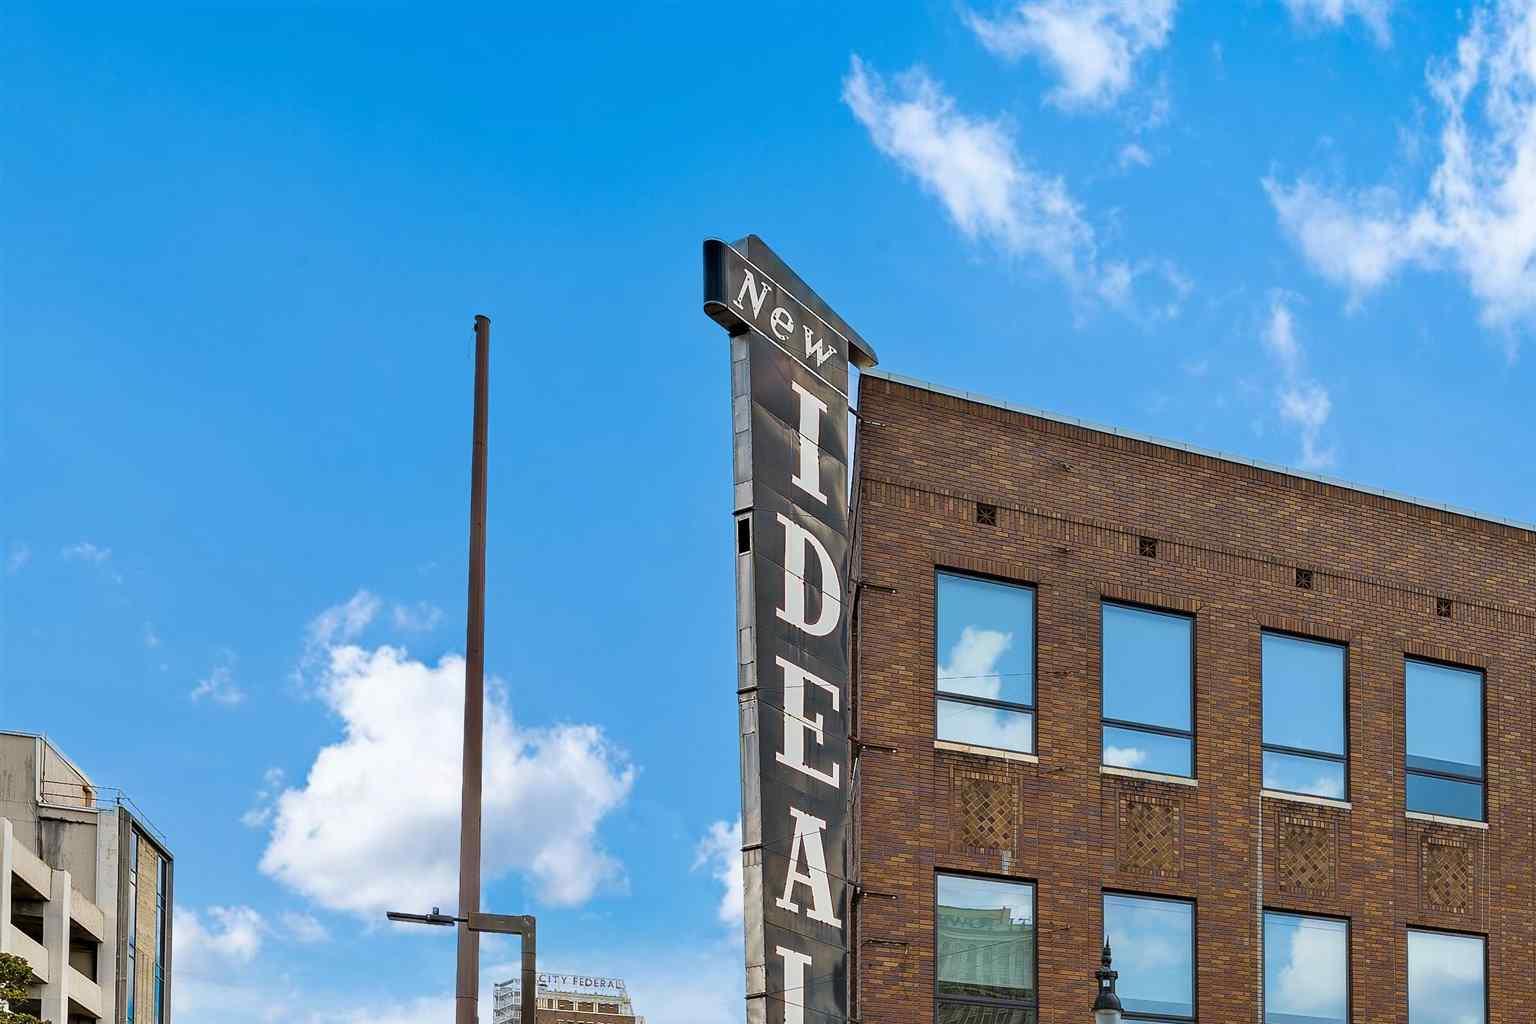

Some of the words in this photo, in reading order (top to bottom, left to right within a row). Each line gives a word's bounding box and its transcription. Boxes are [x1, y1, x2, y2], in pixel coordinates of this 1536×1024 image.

[733, 268, 838, 367] New
[538, 974, 567, 985] CITY
[573, 976, 625, 989] FEDERAL
